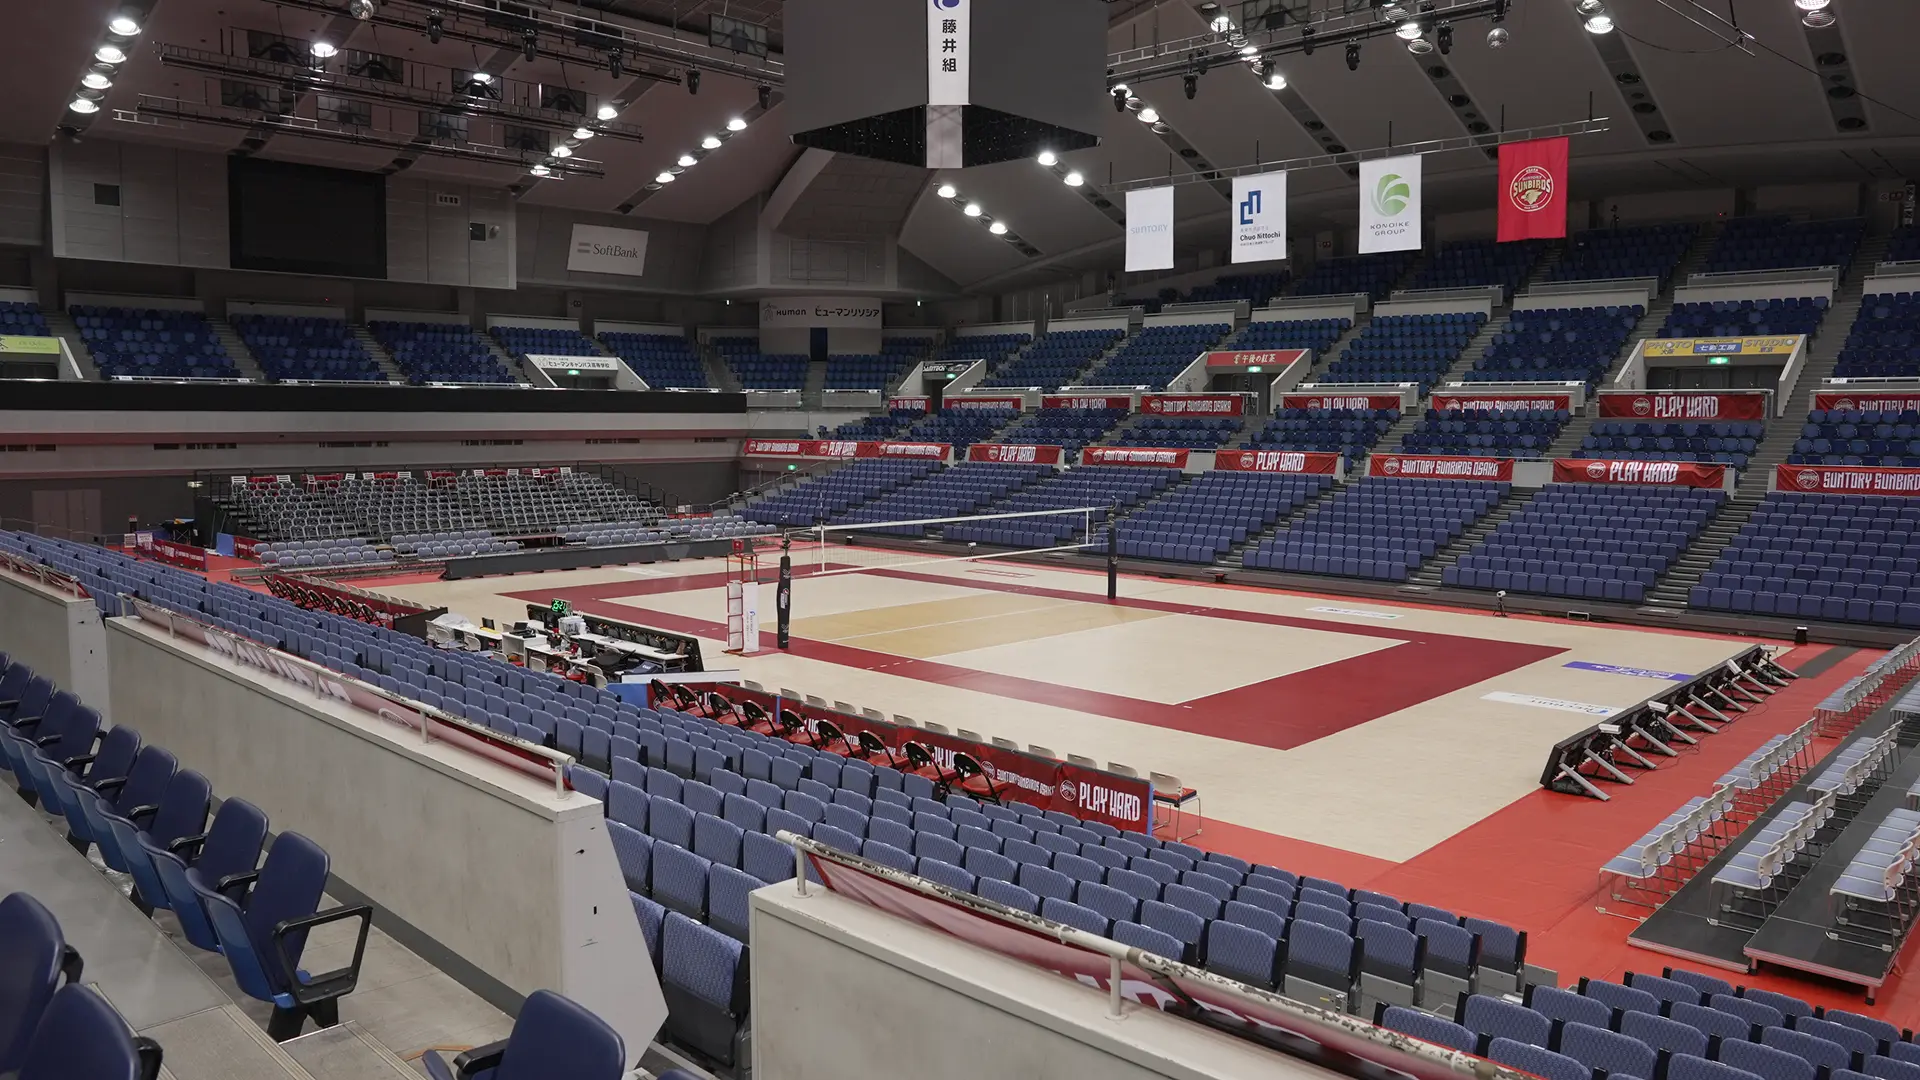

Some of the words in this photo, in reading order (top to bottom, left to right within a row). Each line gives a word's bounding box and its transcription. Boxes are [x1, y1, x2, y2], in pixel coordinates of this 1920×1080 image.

[942, 19, 957, 72] 藤井組
[1513, 178, 1551, 198] SUNBIRDS
[1130, 224, 1168, 234] SUNTORY
[1370, 221, 1410, 230] KONOIKE
[1374, 228, 1406, 237] GROUP
[1257, 231, 1281, 240] Nittochi
[593, 243, 638, 259] SoftBank
[1647, 341, 1693, 350] PHOTO
[1744, 338, 1796, 347] STUDIO
[1654, 396, 1685, 417] PLAY
[1686, 396, 1719, 417] HARD
[999, 446, 1018, 461] PLAY
[1017, 446, 1037, 462] HARD
[1256, 452, 1280, 470] PLAY
[1280, 453, 1305, 471] HARD
[1401, 460, 1435, 474] SUNTORY
[1435, 461, 1473, 475] SUNBIRDS
[1473, 462, 1498, 476] OSAKA
[1609, 461, 1643, 481] PLAY
[1642, 462, 1679, 482] HARD
[1823, 472, 1872, 489] SUNTORY
[1079, 782, 1108, 813] PLAY
[1109, 790, 1141, 821] HARD
